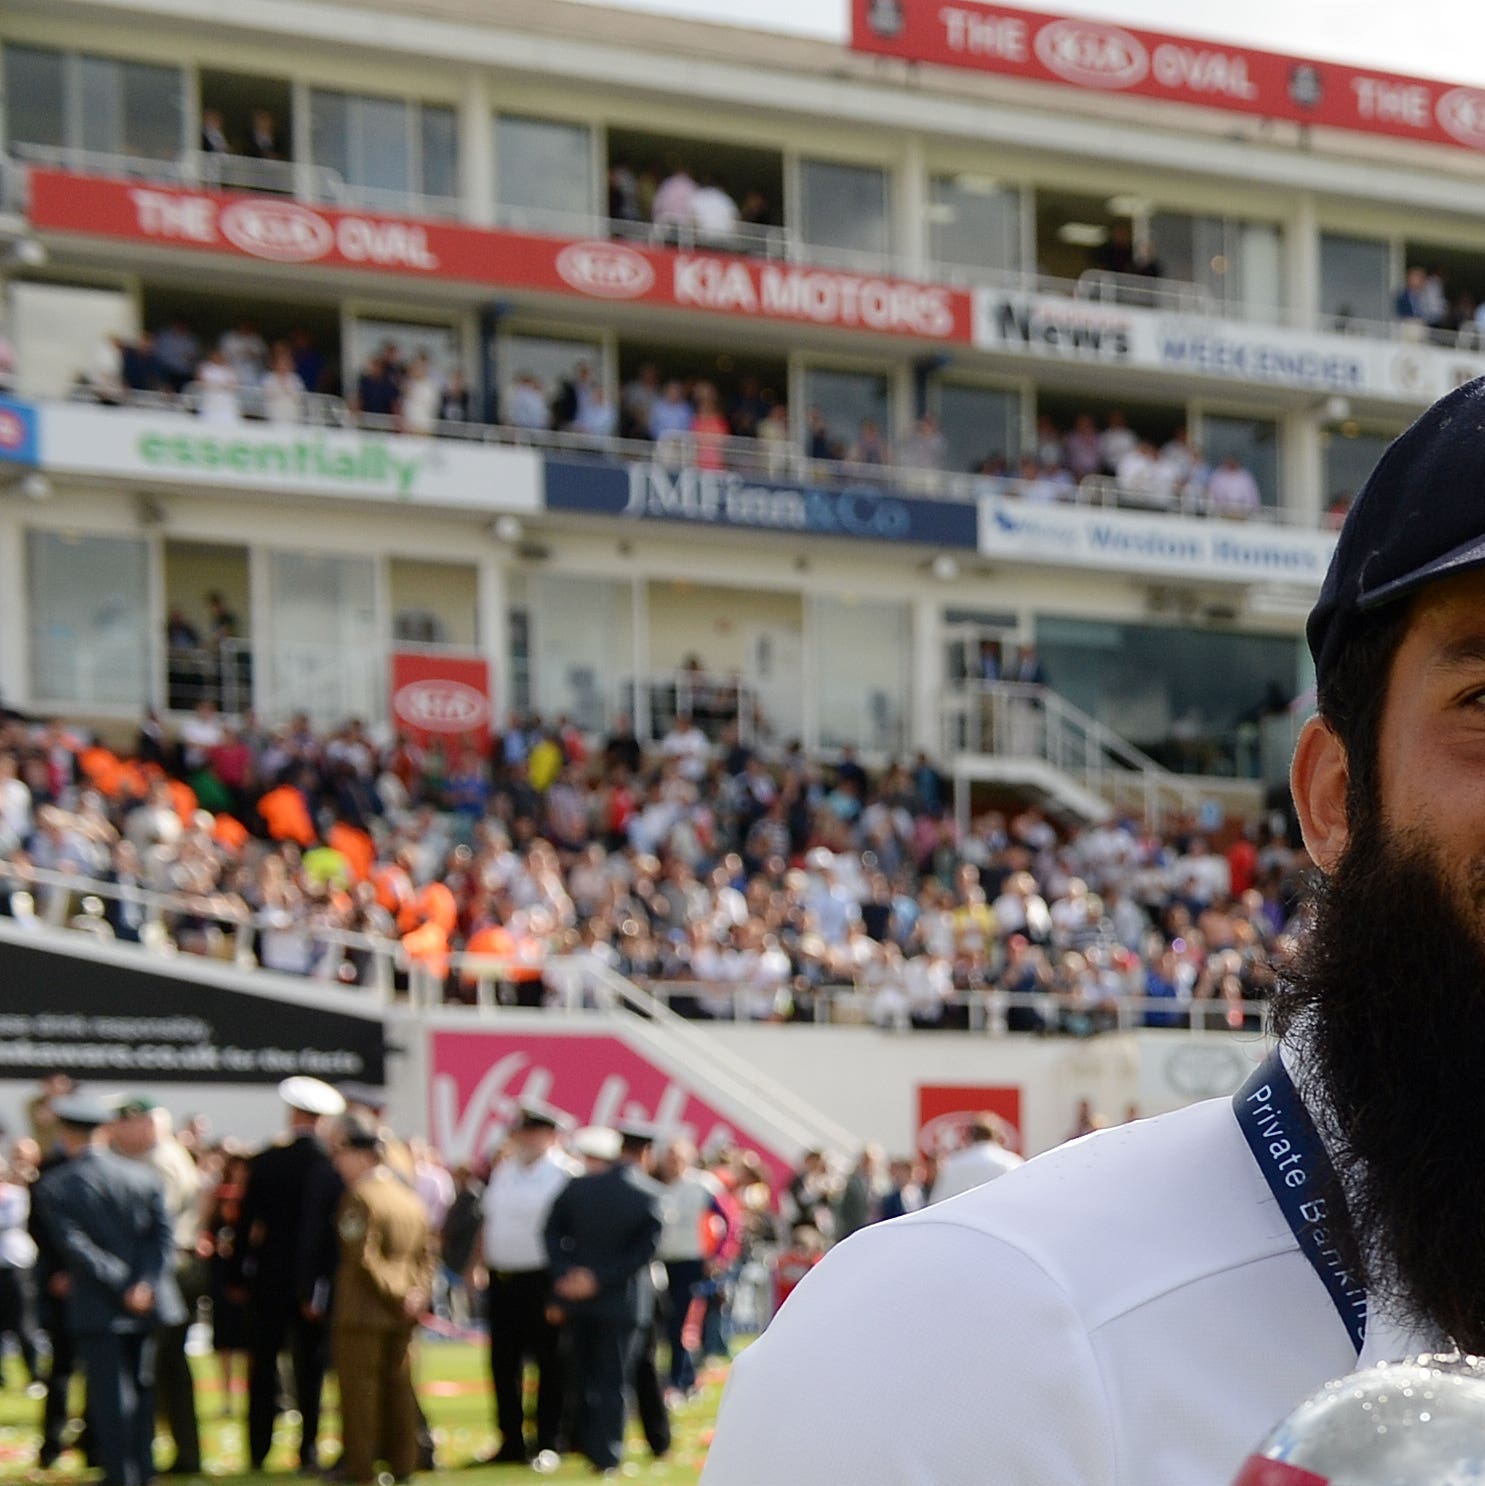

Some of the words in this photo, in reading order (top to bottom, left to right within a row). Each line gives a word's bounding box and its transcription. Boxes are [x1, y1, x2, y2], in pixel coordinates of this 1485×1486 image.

[939, 6, 1029, 63] THE
[1152, 43, 1258, 100] OVAL
[129, 187, 218, 243] THE
[336, 217, 439, 269] OVAL
[673, 254, 757, 313] KIA
[760, 266, 953, 337] MOTORS
[138, 428, 420, 490] essentially
[1247, 1085, 1306, 1188] Private
